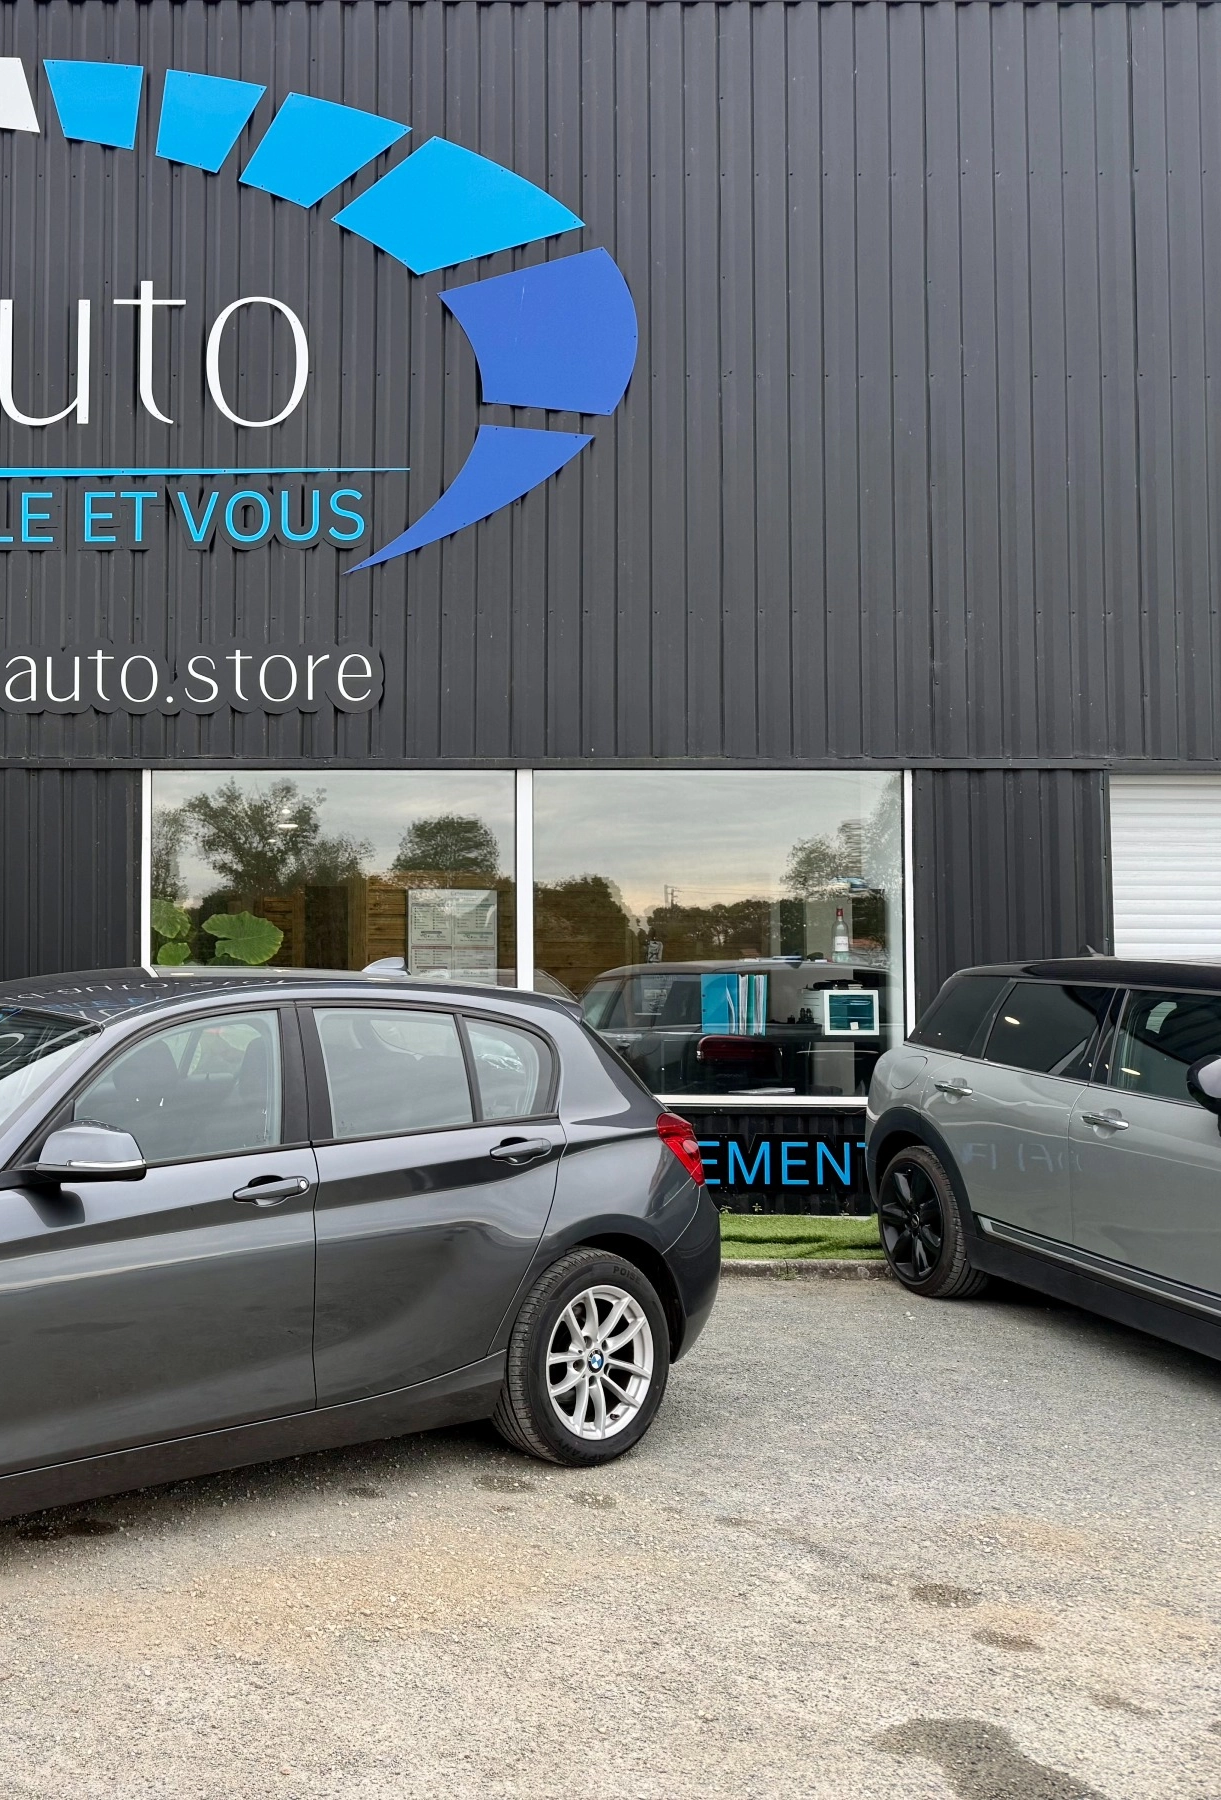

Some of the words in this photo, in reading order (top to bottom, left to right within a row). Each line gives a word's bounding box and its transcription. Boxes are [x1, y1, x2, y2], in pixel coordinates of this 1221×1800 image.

[83, 490, 158, 544] ET
[177, 488, 366, 544] VOUS
[697, 1140, 867, 1186] EMEN
[613, 1265, 641, 1285] POISE
